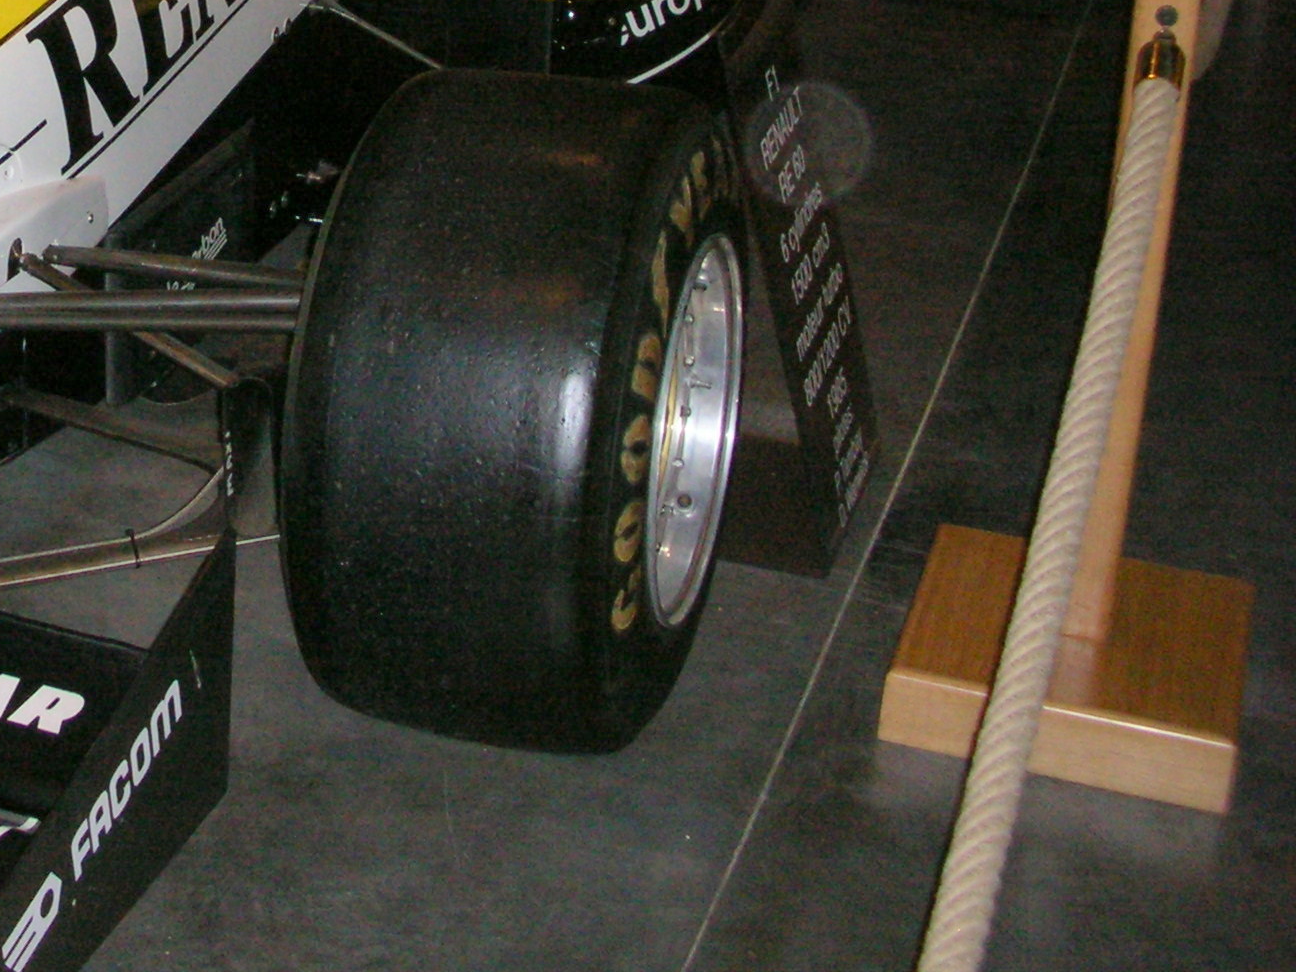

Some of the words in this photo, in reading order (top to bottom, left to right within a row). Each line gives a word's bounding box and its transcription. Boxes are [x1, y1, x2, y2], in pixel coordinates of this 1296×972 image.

[764, 64, 781, 102] F1
[760, 85, 804, 171] RENAULT
[778, 160, 796, 205] RE
[780, 232, 792, 264] 6
[70, 679, 184, 882] FACOM
